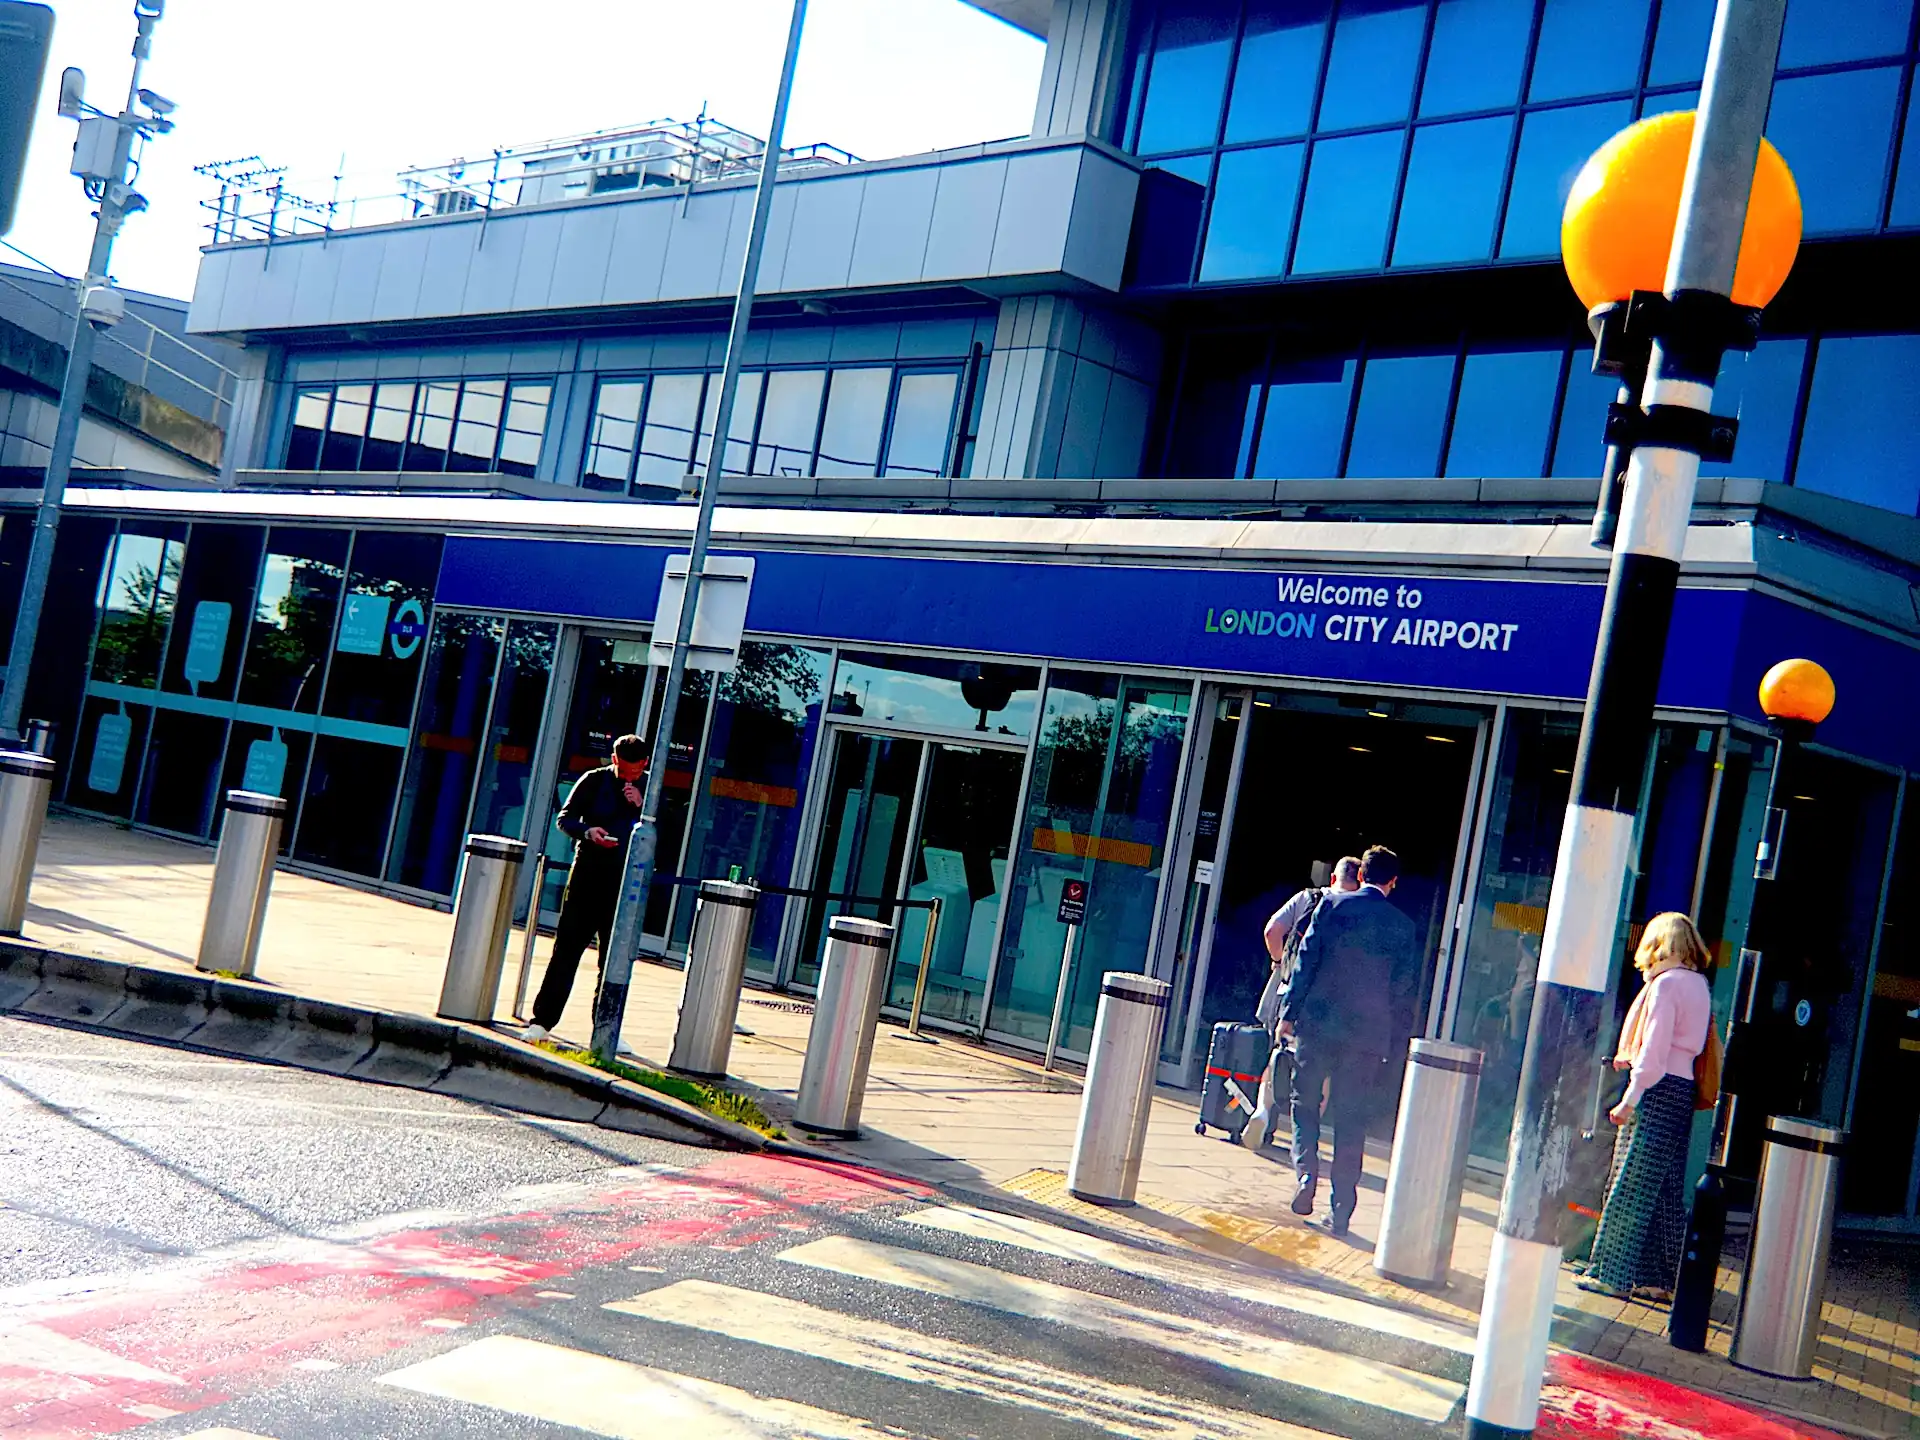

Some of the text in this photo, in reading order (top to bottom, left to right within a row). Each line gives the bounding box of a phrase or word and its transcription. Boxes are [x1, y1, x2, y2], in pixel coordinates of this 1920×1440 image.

[1277, 577, 1422, 609] Welcome to
[1205, 608, 1518, 652] LONDON CITY AIRPORT
